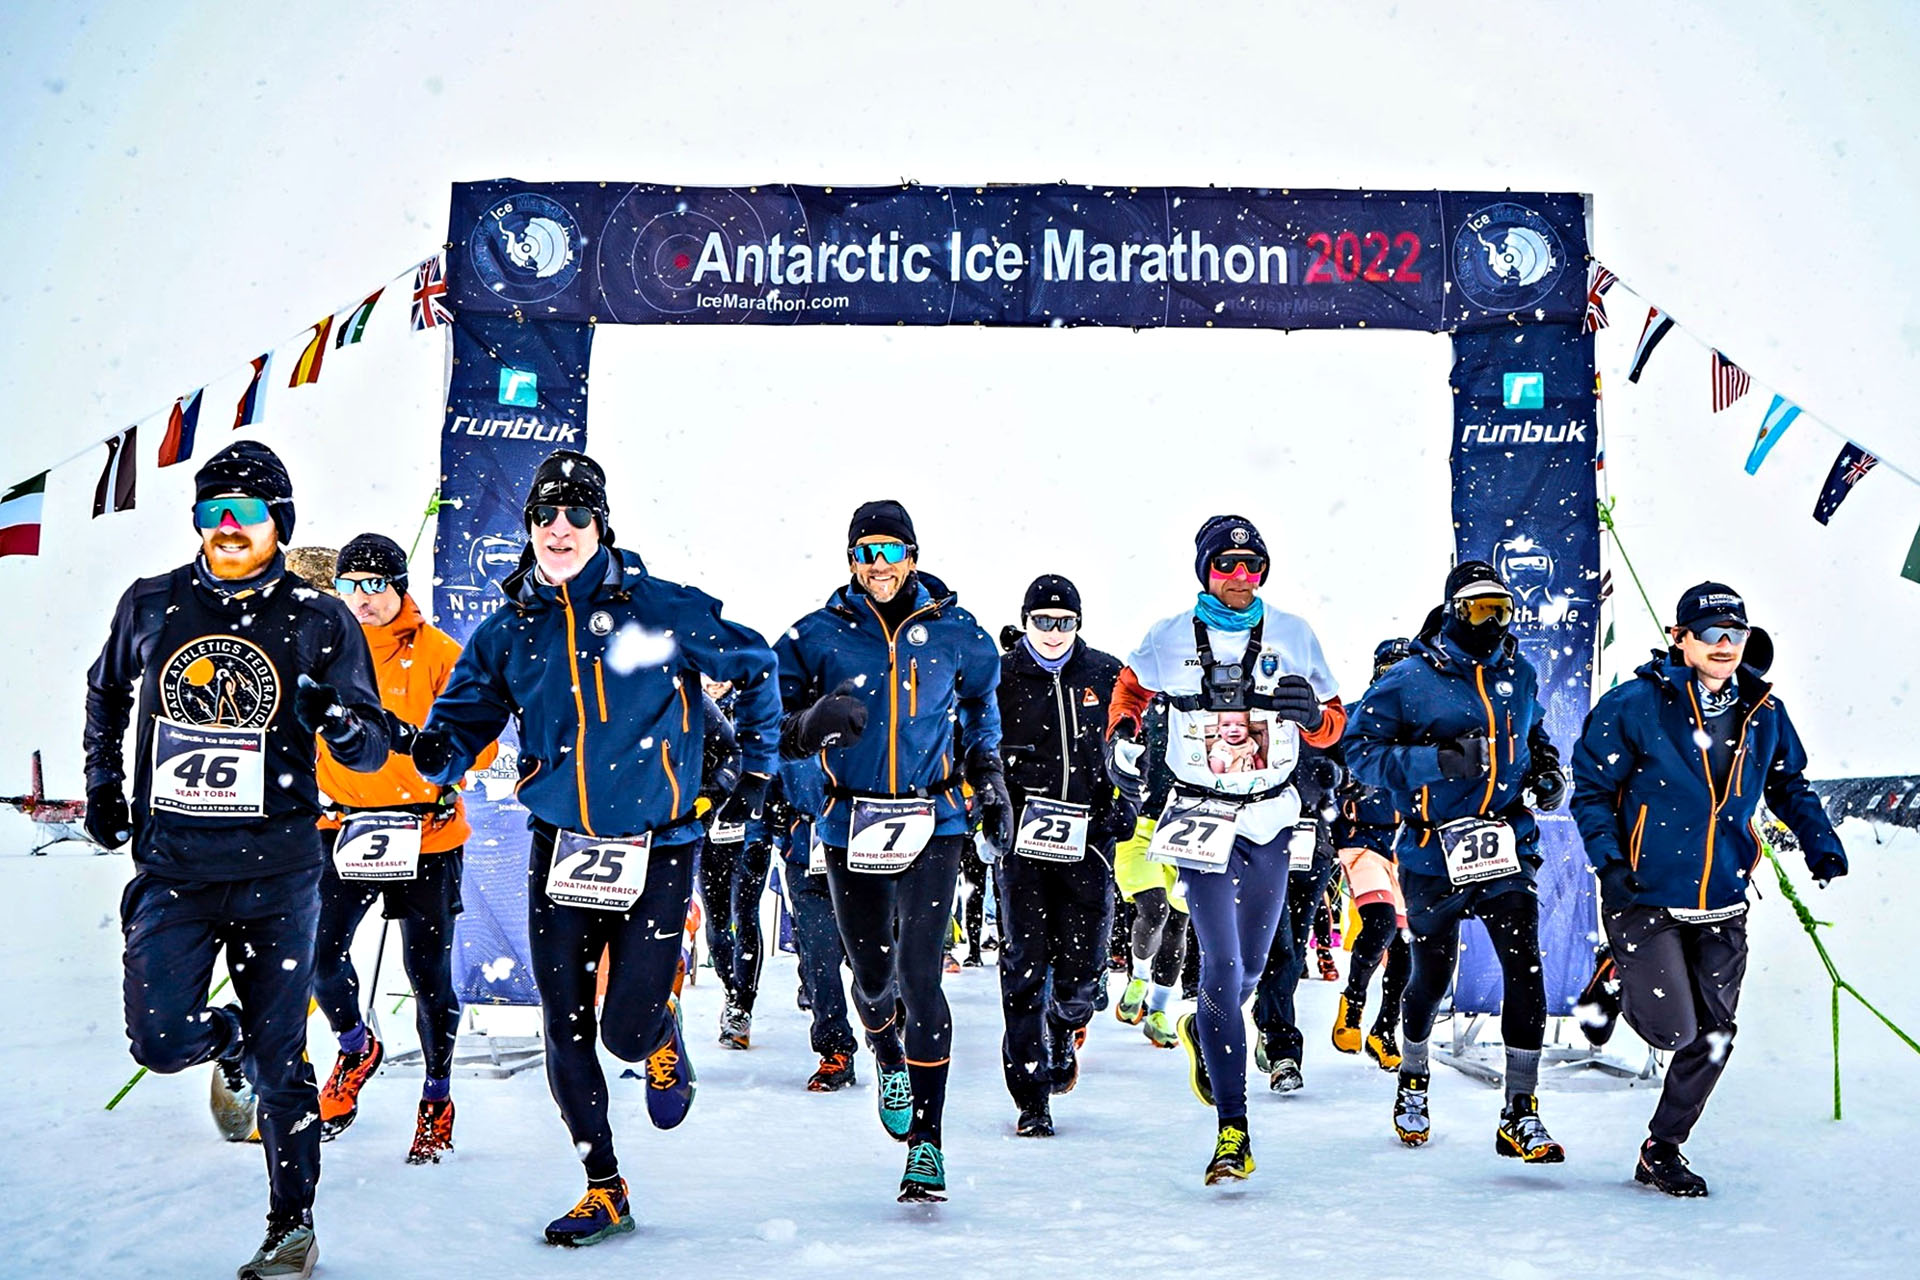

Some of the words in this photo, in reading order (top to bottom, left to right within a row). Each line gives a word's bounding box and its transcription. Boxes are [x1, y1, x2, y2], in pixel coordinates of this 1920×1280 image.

[490, 203, 513, 220] Ice
[1467, 214, 1490, 232] Ice
[692, 230, 932, 284] Antarctic
[951, 231, 1023, 282] Ice
[1043, 228, 1288, 284] Marathon
[1304, 230, 1422, 284] 2022
[697, 293, 849, 311] IceMarathon.com
[450, 416, 581, 443] runbuk
[1461, 420, 1588, 443] runbuk
[169, 641, 242, 679] ATHLETICS
[244, 651, 274, 729] FEDERATION
[170, 731, 204, 743] Antarctic
[205, 736, 218, 744] Ice
[218, 737, 258, 746] Marathon
[174, 753, 240, 789] 46
[157, 798, 256, 811] WWW.ICEMARATHON.COM
[175, 788, 200, 798] SEAN
[204, 790, 237, 798] TOBIN
[882, 822, 906, 851] 7
[1033, 816, 1071, 843] 23
[1168, 818, 1219, 847] 27
[362, 834, 390, 860] 3
[1462, 831, 1499, 864] 38
[569, 848, 626, 884] 25
[553, 880, 598, 891] JONATHAN
[599, 885, 639, 896] HERRICK
